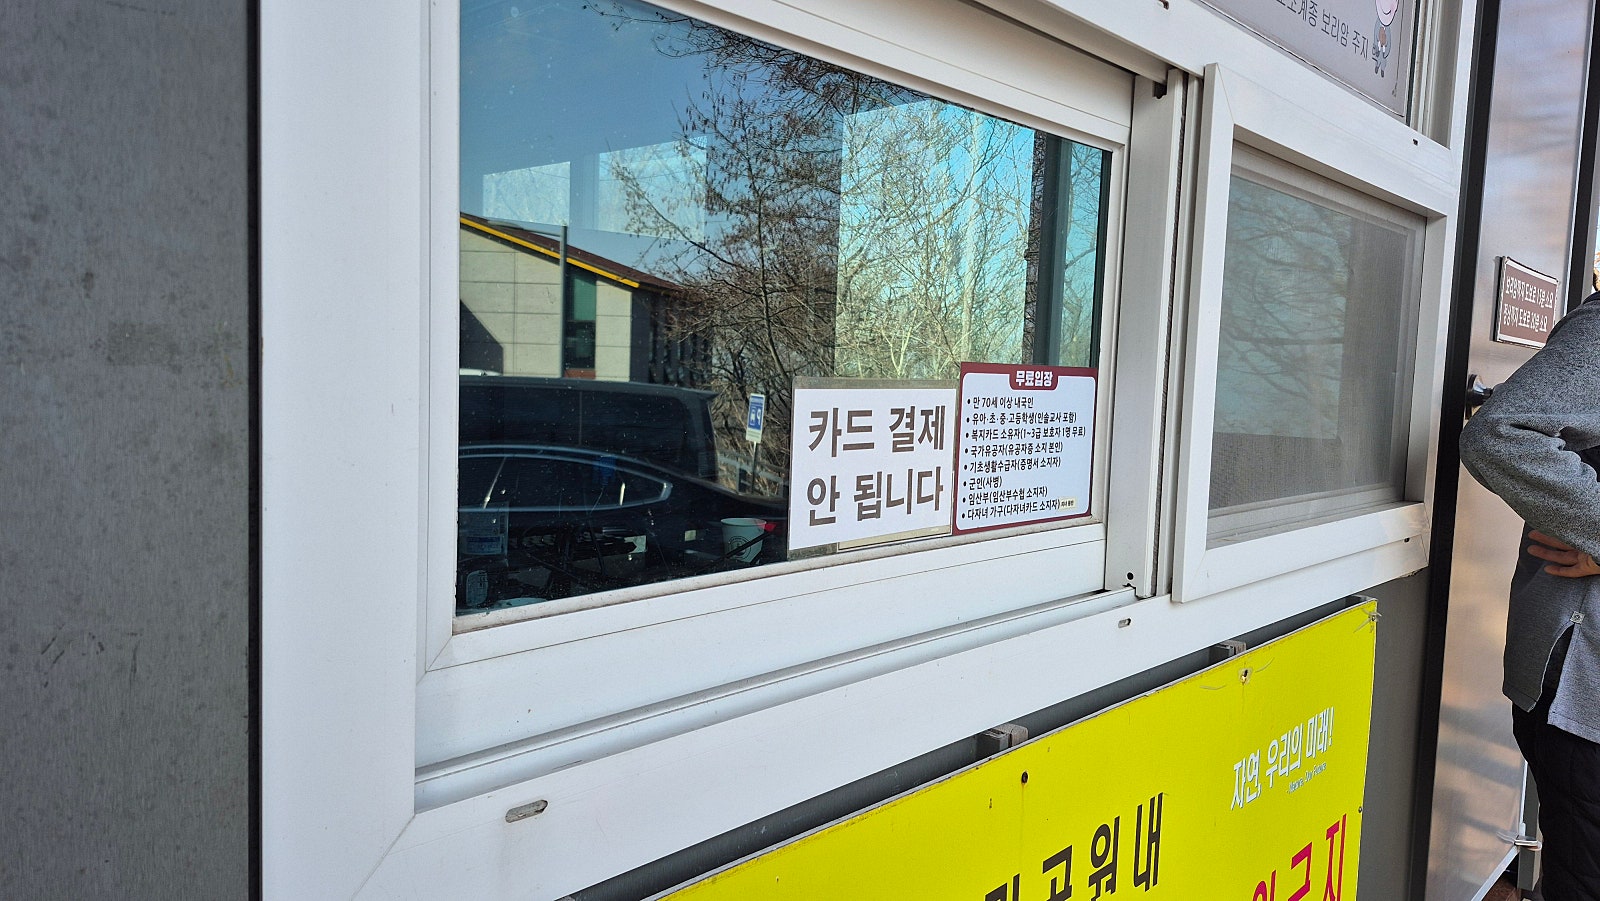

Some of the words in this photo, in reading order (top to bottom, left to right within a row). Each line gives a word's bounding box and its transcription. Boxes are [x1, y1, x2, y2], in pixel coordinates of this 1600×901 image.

[1322, 9, 1349, 47] 보리암
[1352, 30, 1369, 60] 주지
[1015, 371, 1053, 386] 무료입장
[973, 397, 980, 409] 만
[982, 397, 998, 408] 70세
[1000, 398, 1013, 408] 이상
[1014, 397, 1034, 408] 내국인
[1063, 412, 1077, 424] 포함)
[809, 408, 874, 457] 카드
[889, 406, 945, 452] 결제
[972, 428, 998, 441] 복지카드
[1043, 427, 1061, 438] 보호자
[1062, 428, 1071, 438] 1명
[1072, 426, 1086, 437] 무료)
[971, 443, 1033, 458] 국가유공자(유공자증
[1035, 442, 1047, 451] 소지
[1048, 442, 1063, 453] 본인)
[970, 458, 1039, 473] 기초생활수급자(증명서
[1040, 456, 1061, 468] 소지자)
[969, 476, 1002, 490] 군인(사병)
[807, 475, 840, 526] 안
[854, 466, 943, 521] 됩니다
[968, 488, 1025, 506] 임산부(임산부수첩
[1027, 486, 1048, 498] 소지자)
[968, 506, 988, 520] 다자녀
[990, 501, 1038, 518] 가구(다자녀카드
[1040, 499, 1060, 511] 소지자)
[1231, 749, 1262, 810] 자연,
[1266, 723, 1304, 788] 우리의
[1306, 706, 1334, 758] 미래!
